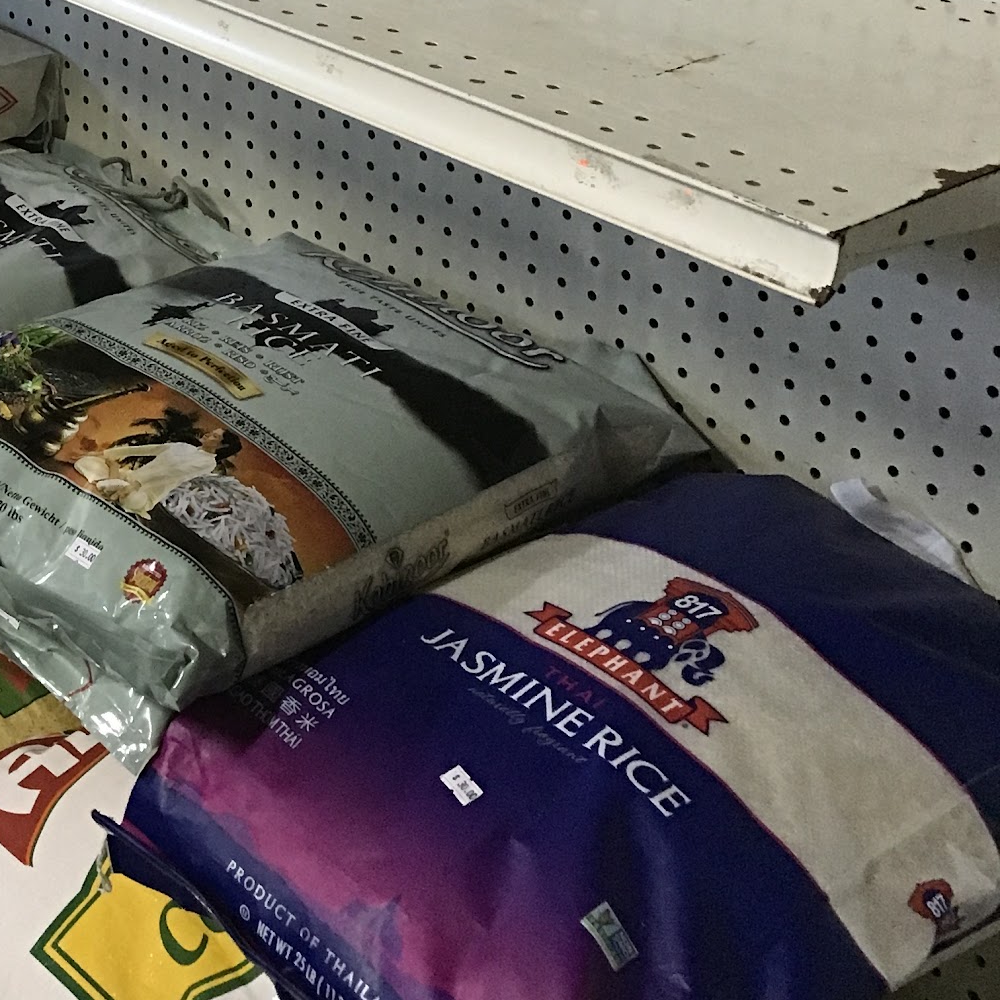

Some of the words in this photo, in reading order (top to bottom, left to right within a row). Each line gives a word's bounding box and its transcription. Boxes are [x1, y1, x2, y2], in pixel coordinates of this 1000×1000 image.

[15, 203, 49, 226] EXTRA
[289, 299, 336, 323] EXTRA
[338, 323, 371, 343] FINE
[338, 280, 366, 296] TRUE
[369, 294, 402, 315] TASTE
[404, 314, 447, 339] UNITES
[214, 292, 384, 378] BASMATI
[198, 354, 247, 391] Perfection
[7, 507, 25, 525] lbs
[22, 496, 60, 527] Gewicht
[674, 594, 723, 620] 817
[543, 621, 684, 715] ELEPHANT
[420, 627, 596, 739] JASMINE
[582, 724, 692, 818] RICE
[225, 859, 297, 927] PRODUCT
[299, 926, 321, 949] OF
[926, 893, 950, 919] 817
[256, 919, 277, 947] NET
[275, 938, 294, 961] WT
[293, 951, 307, 972] 25
[305, 963, 318, 985] LB
